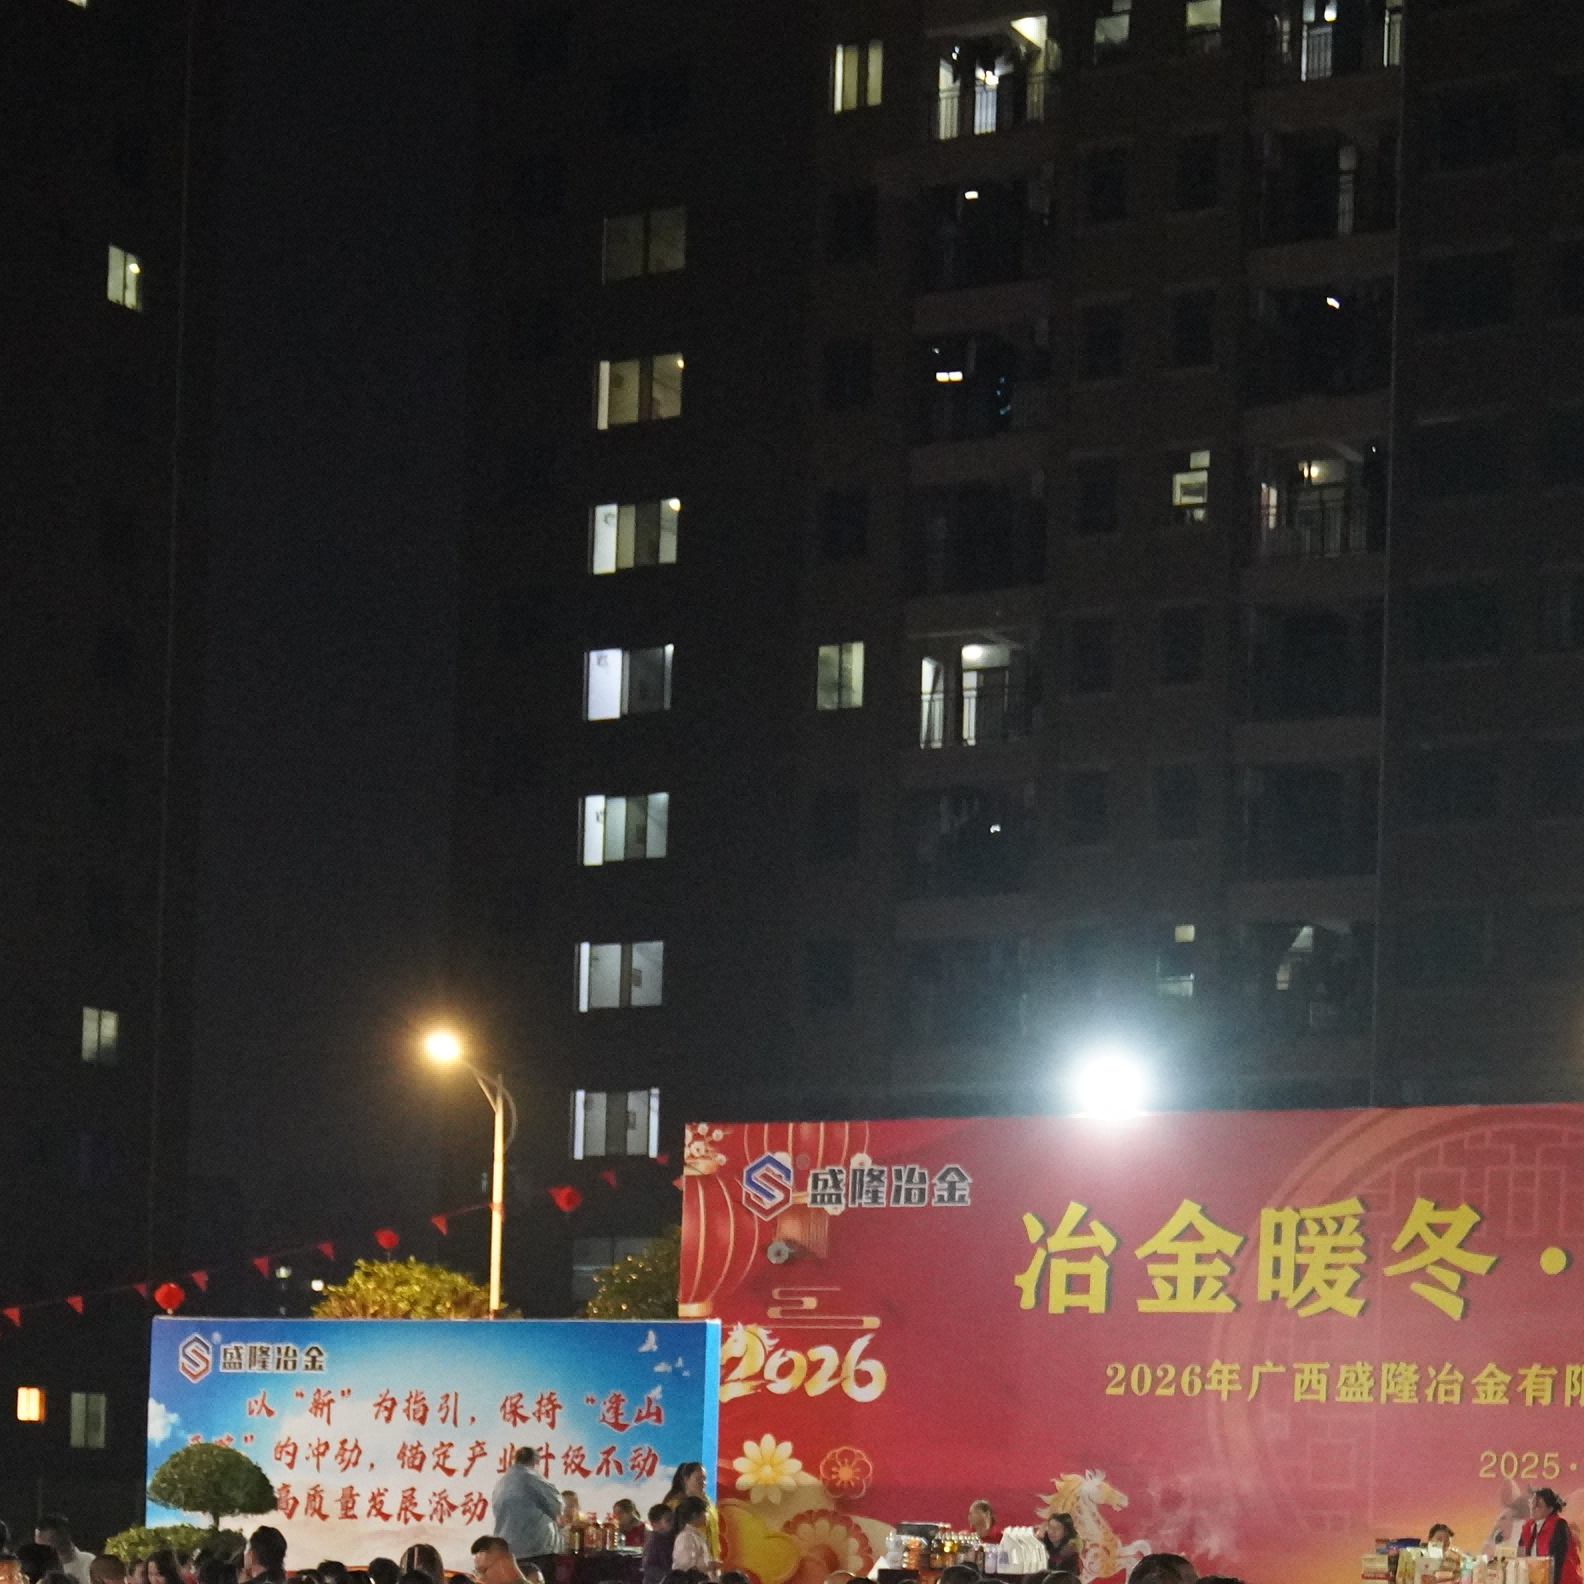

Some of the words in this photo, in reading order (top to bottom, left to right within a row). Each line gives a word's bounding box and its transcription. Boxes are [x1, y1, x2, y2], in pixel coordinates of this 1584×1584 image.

[808, 1165, 972, 1207] 盛隆冶金
[221, 1344, 325, 1372] 盛隆冶金
[719, 1322, 887, 1402] 2026
